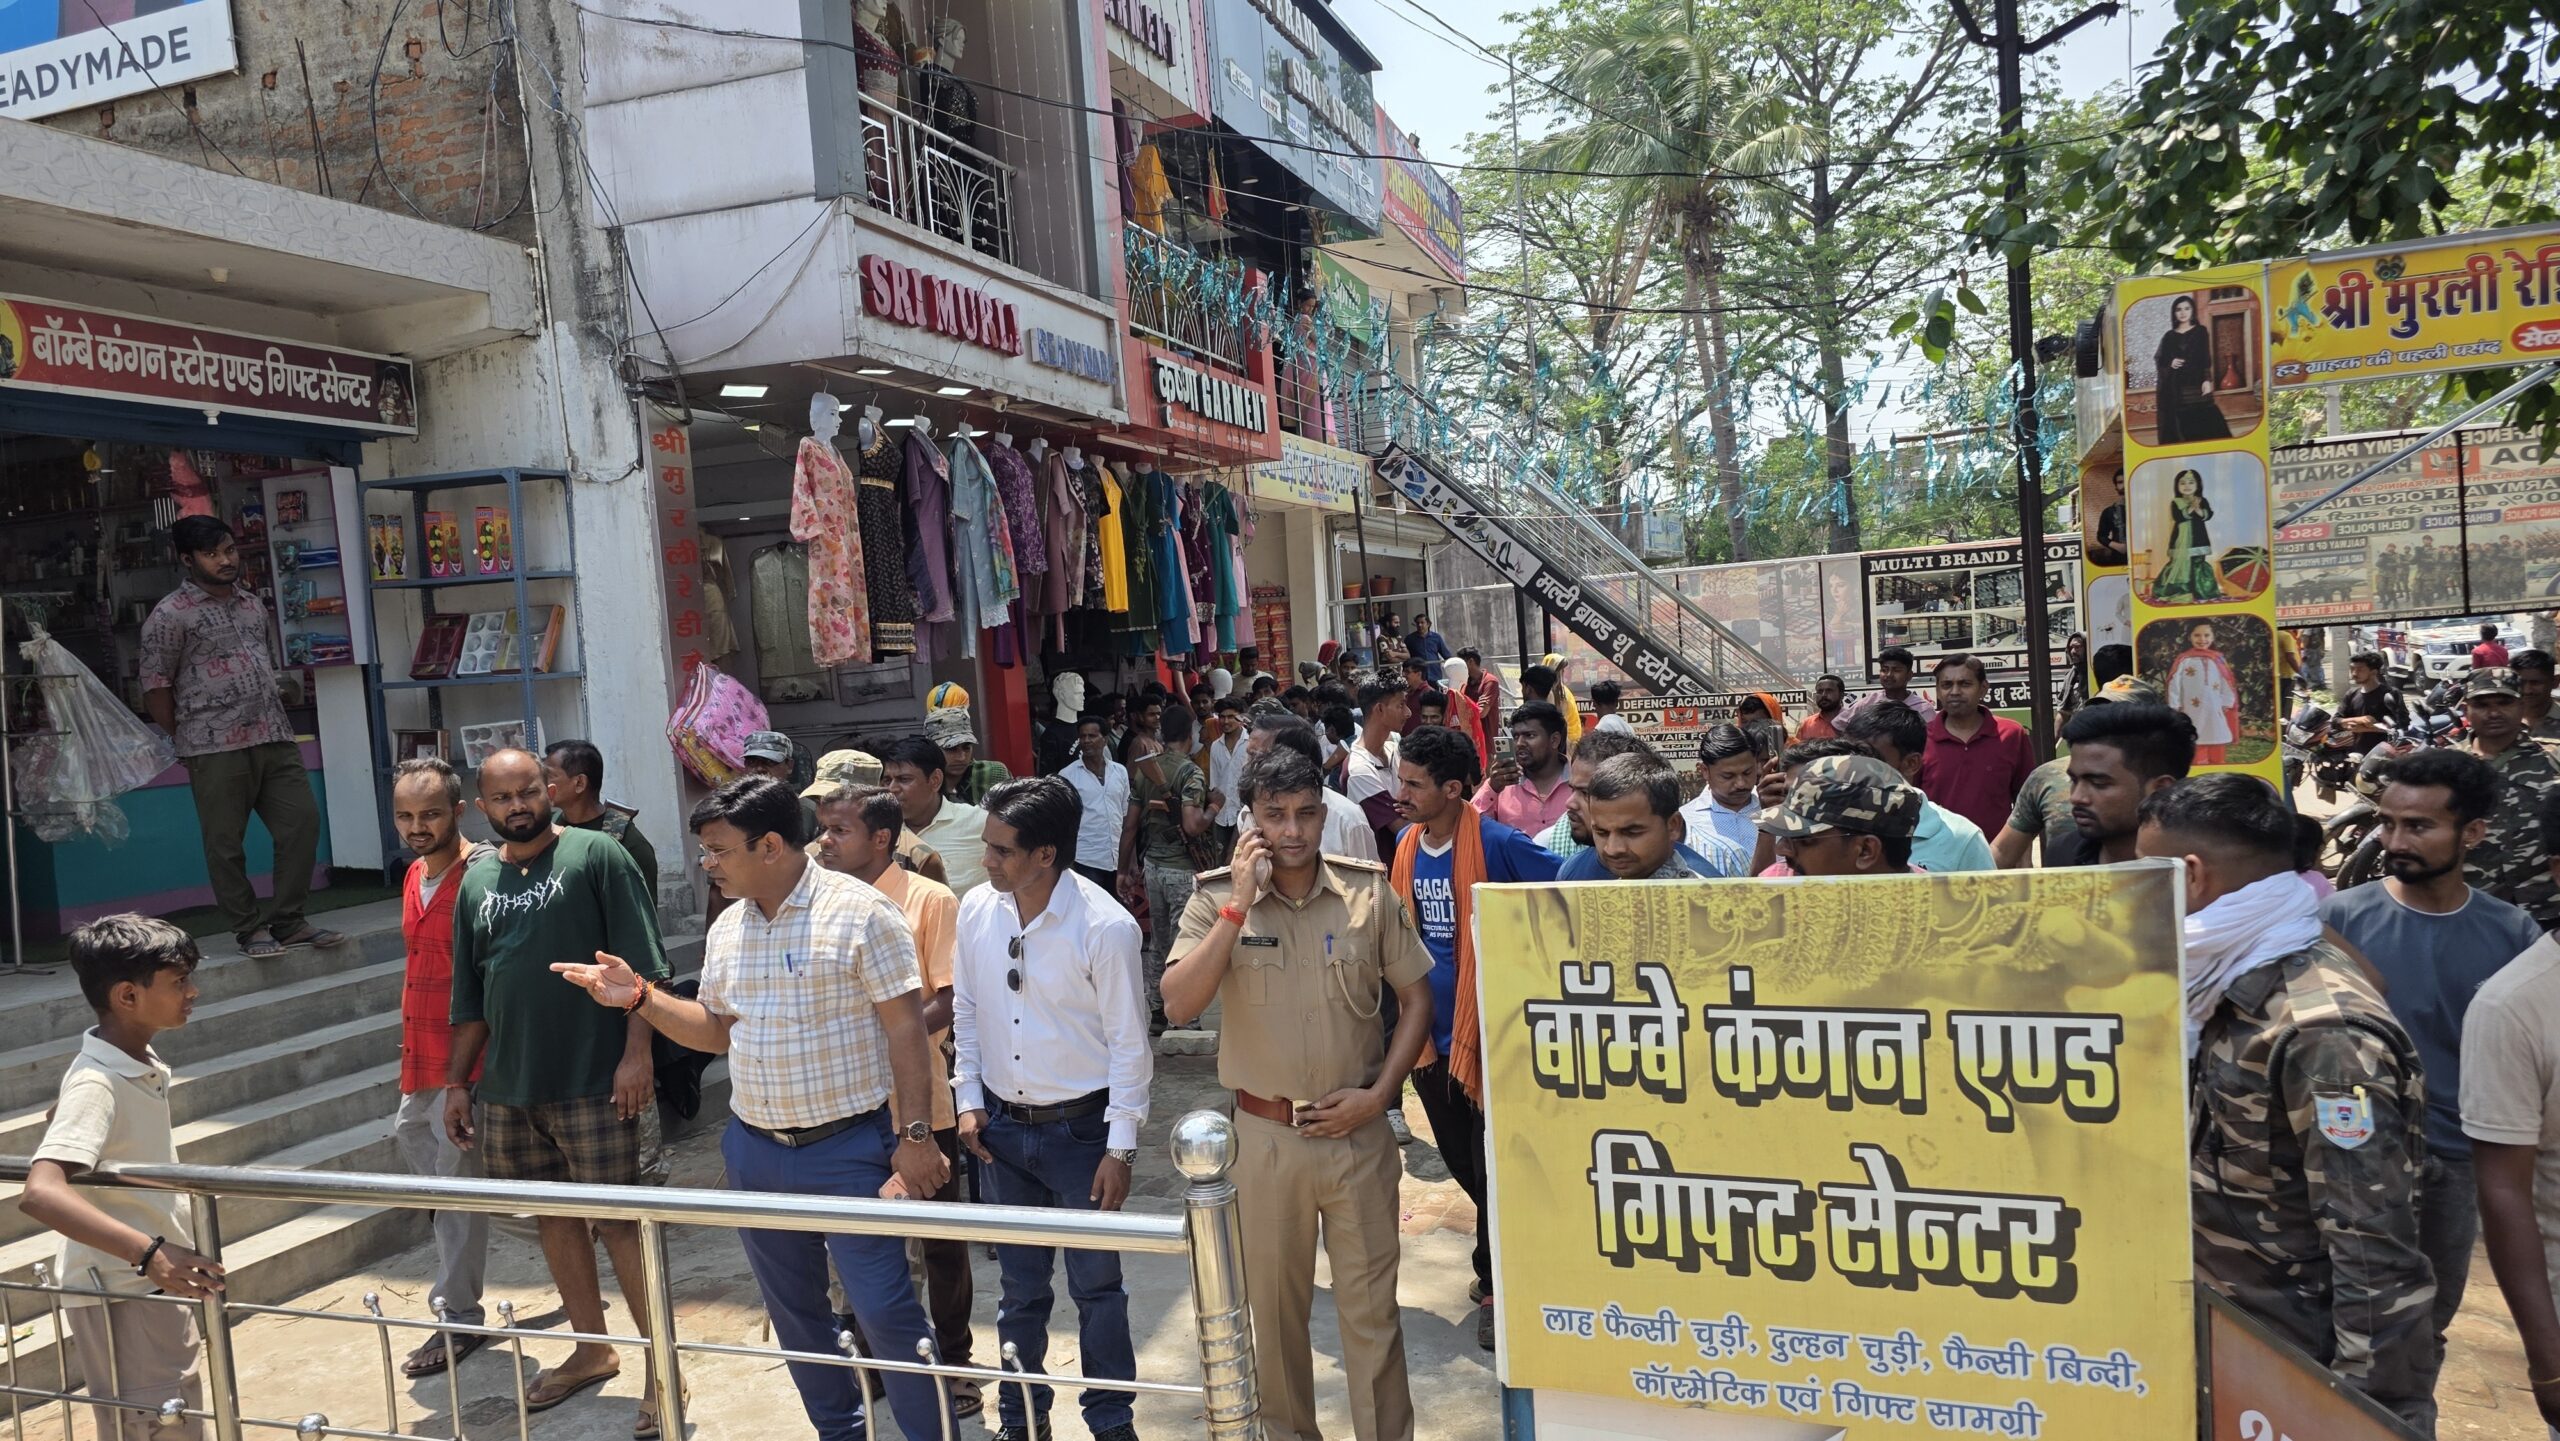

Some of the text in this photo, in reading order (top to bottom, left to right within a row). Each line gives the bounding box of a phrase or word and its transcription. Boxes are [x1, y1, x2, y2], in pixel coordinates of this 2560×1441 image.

[1287, 57, 1371, 156] SHOE STORE
[860, 254, 927, 327] SRI
[2319, 267, 2376, 330] श्री
[2380, 253, 2502, 341] मुरली
[30, 314, 94, 371] बॉम्बे
[94, 322, 167, 381] कंगन
[222, 352, 264, 397] एण्ड
[264, 345, 320, 400] गिफ्ट
[318, 356, 372, 408] सेन्टर
[2366, 349, 2393, 368] की
[2396, 343, 2450, 364] पहली
[2452, 338, 2503, 358] पसंद
[1201, 372, 1269, 434] GARMENT
[1870, 544, 2080, 572] MULTI BRAND SOE
[1535, 570, 1581, 611] मल्टी
[1612, 632, 1636, 666] शू
[1635, 649, 1677, 687] स्टोर
[1616, 711, 1659, 724] DA
[1623, 697, 1674, 710] DEFENCE
[1676, 695, 1732, 708] ACADEMY
[1678, 750, 1700, 759] POLICE
[1413, 878, 1454, 900] GAGA
[1525, 960, 2122, 1132] बॉम्बे कंगन एण्ड
[1587, 1128, 2081, 1305] गिफ्ट सेन्टर
[1542, 1305, 1595, 1337] लाह
[1603, 1305, 1682, 1346] फैन्सी
[1767, 1326, 1850, 1363] दुल्हन
[1942, 1337, 2034, 1380] फैन्सी
[2046, 1345, 2149, 1395] बिन्दी,
[1632, 1364, 2043, 1440] कॉस्मेटिक एवं गिफ्ट सामग्री
